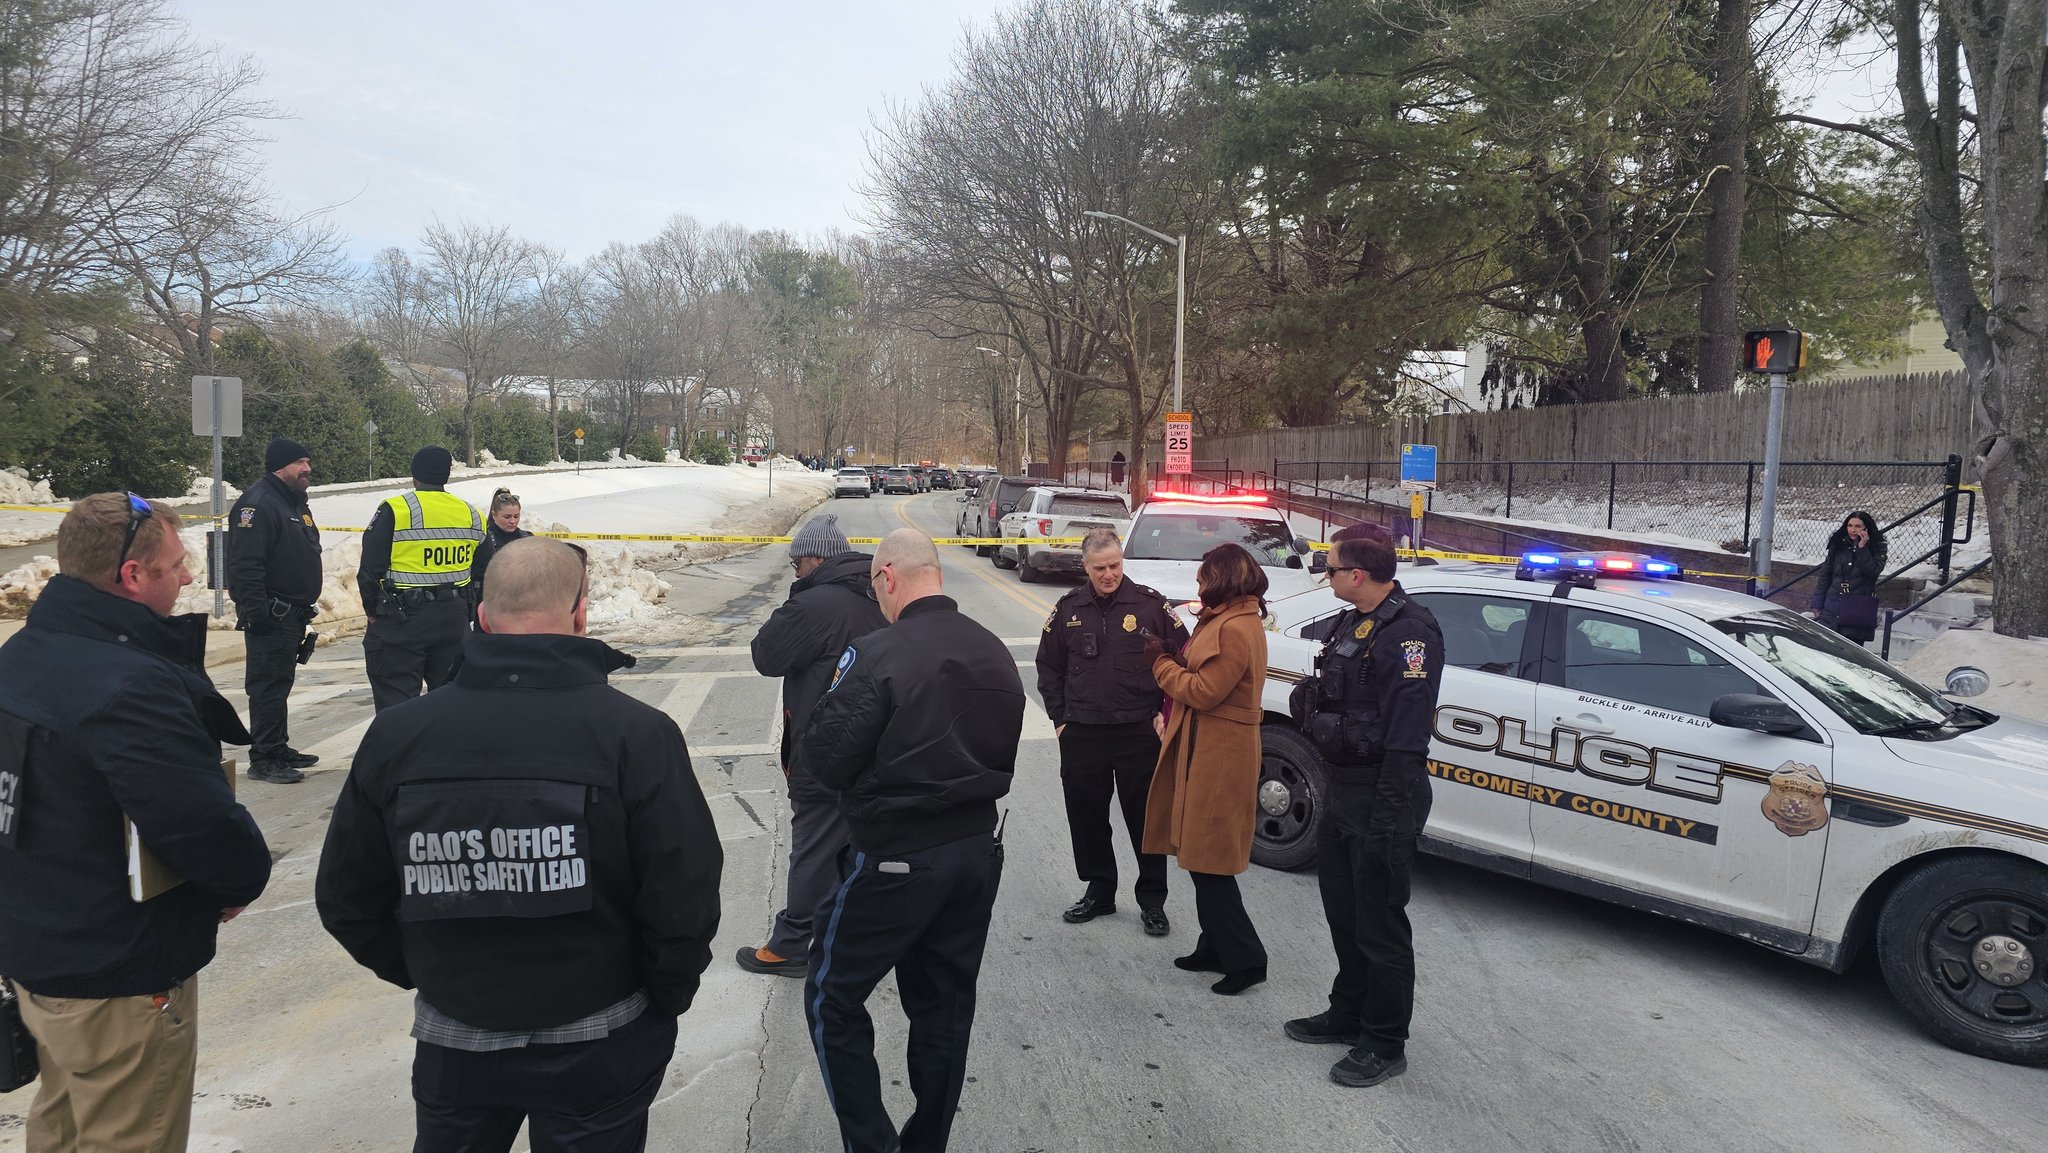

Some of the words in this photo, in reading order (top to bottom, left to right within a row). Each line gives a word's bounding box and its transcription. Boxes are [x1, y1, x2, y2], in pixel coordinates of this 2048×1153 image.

[1169, 438, 1188, 450] 25
[424, 544, 471, 567] POLICE
[1400, 640, 1426, 648] POLICE
[1578, 695, 1619, 709] BUCKLE
[1621, 704, 1636, 712] UP
[1643, 708, 1685, 723] ARRIVE
[1687, 718, 1714, 729] ALIV
[1431, 704, 1725, 805] OLICE
[1779, 786, 1816, 800] OFFICER
[1784, 779, 1812, 789] POLICE
[1425, 761, 1564, 806] NTGOMERY
[1571, 795, 1697, 837] COUNTY
[409, 829, 486, 863] CAO'S
[490, 824, 577, 860] OFFICE
[403, 863, 472, 896] PUBLIC
[473, 861, 535, 893] SAFETY
[538, 857, 587, 892] LEAD
